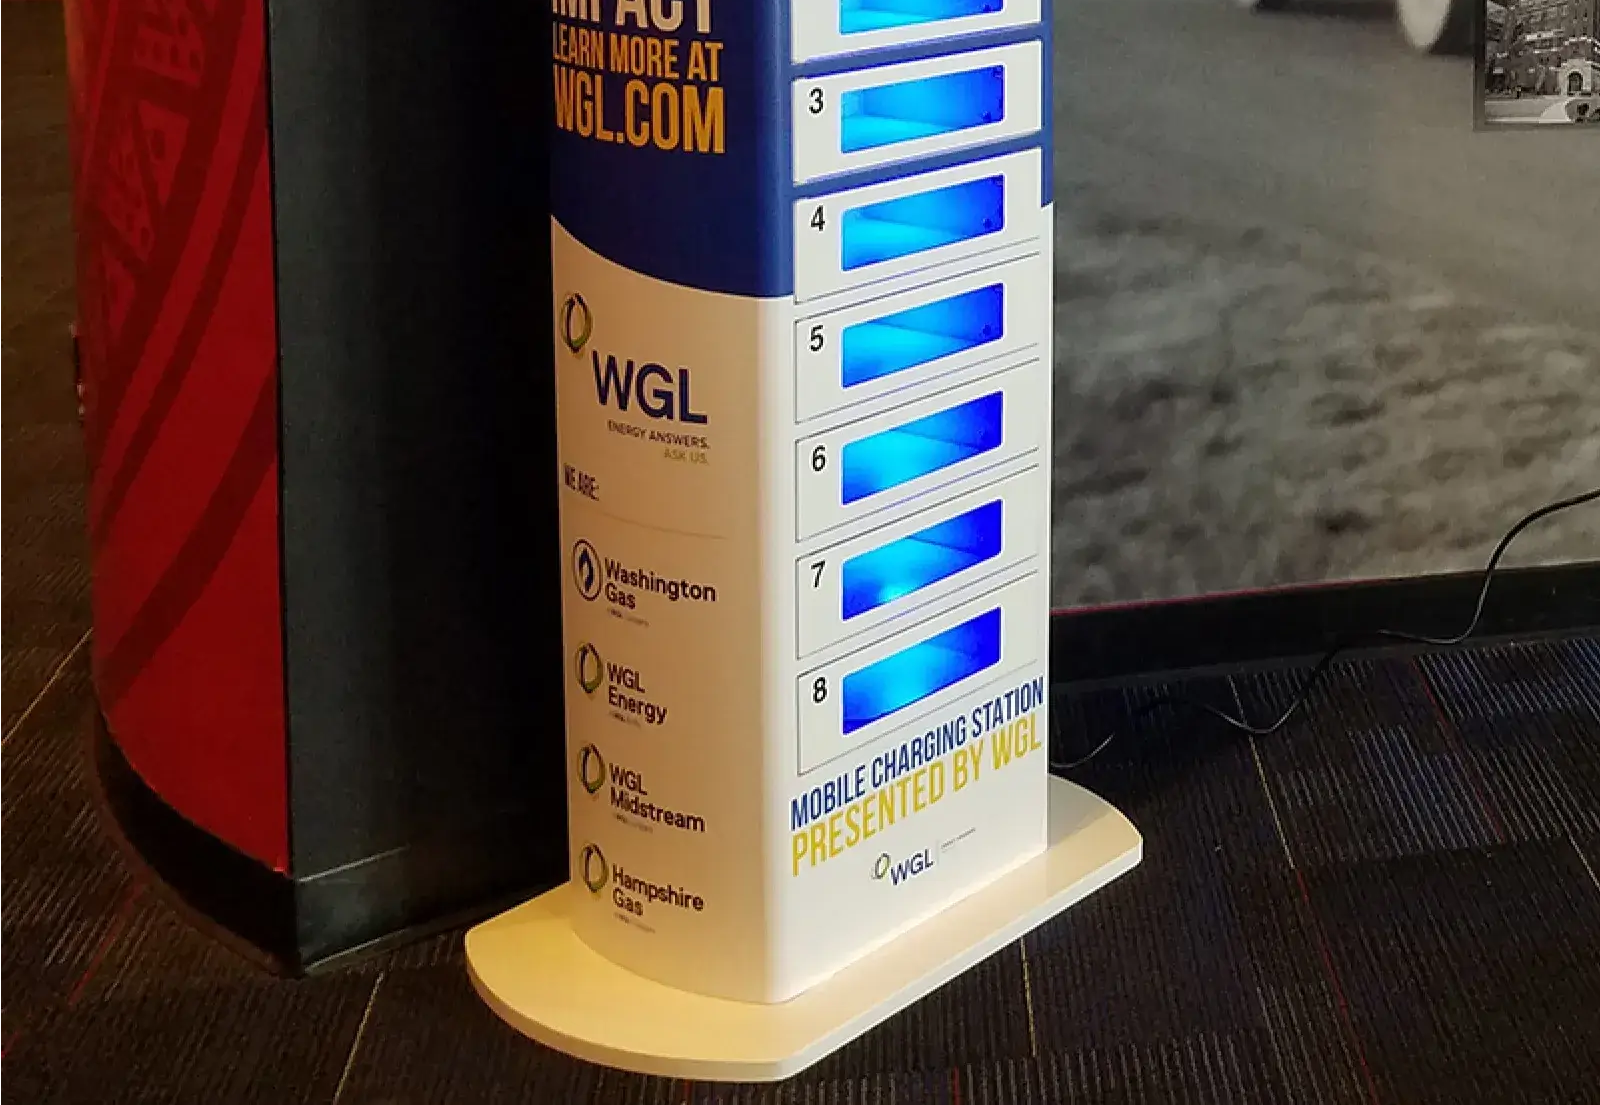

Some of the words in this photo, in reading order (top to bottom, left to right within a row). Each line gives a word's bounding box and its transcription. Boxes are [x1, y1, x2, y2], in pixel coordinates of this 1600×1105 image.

[552, 20, 604, 70] LEARN
[610, 31, 680, 79] MORE
[686, 40, 724, 82] AT
[552, 63, 726, 154] WGL.COM
[809, 87, 825, 115] 3
[810, 205, 826, 232] 4
[810, 325, 825, 353] 5
[591, 349, 708, 424] WGL
[606, 419, 647, 440] ENERGY
[811, 445, 827, 472] 6
[604, 556, 717, 602] Washington
[810, 560, 826, 589] 7
[604, 581, 636, 610] Gas
[606, 661, 646, 694] WGL
[812, 676, 828, 704] 8
[608, 684, 668, 726] Energy
[790, 765, 866, 832] MOBILE
[870, 714, 967, 788] CHARGING
[971, 675, 1045, 738] STATION
[608, 762, 648, 796] WGL
[792, 760, 945, 878] PRESENTED
[953, 738, 985, 792] BY
[991, 712, 1042, 771] WGL
[610, 786, 706, 833] Midstream
[890, 848, 934, 886] WGL
[612, 862, 705, 912] Hampshire
[612, 887, 644, 917] Gas
